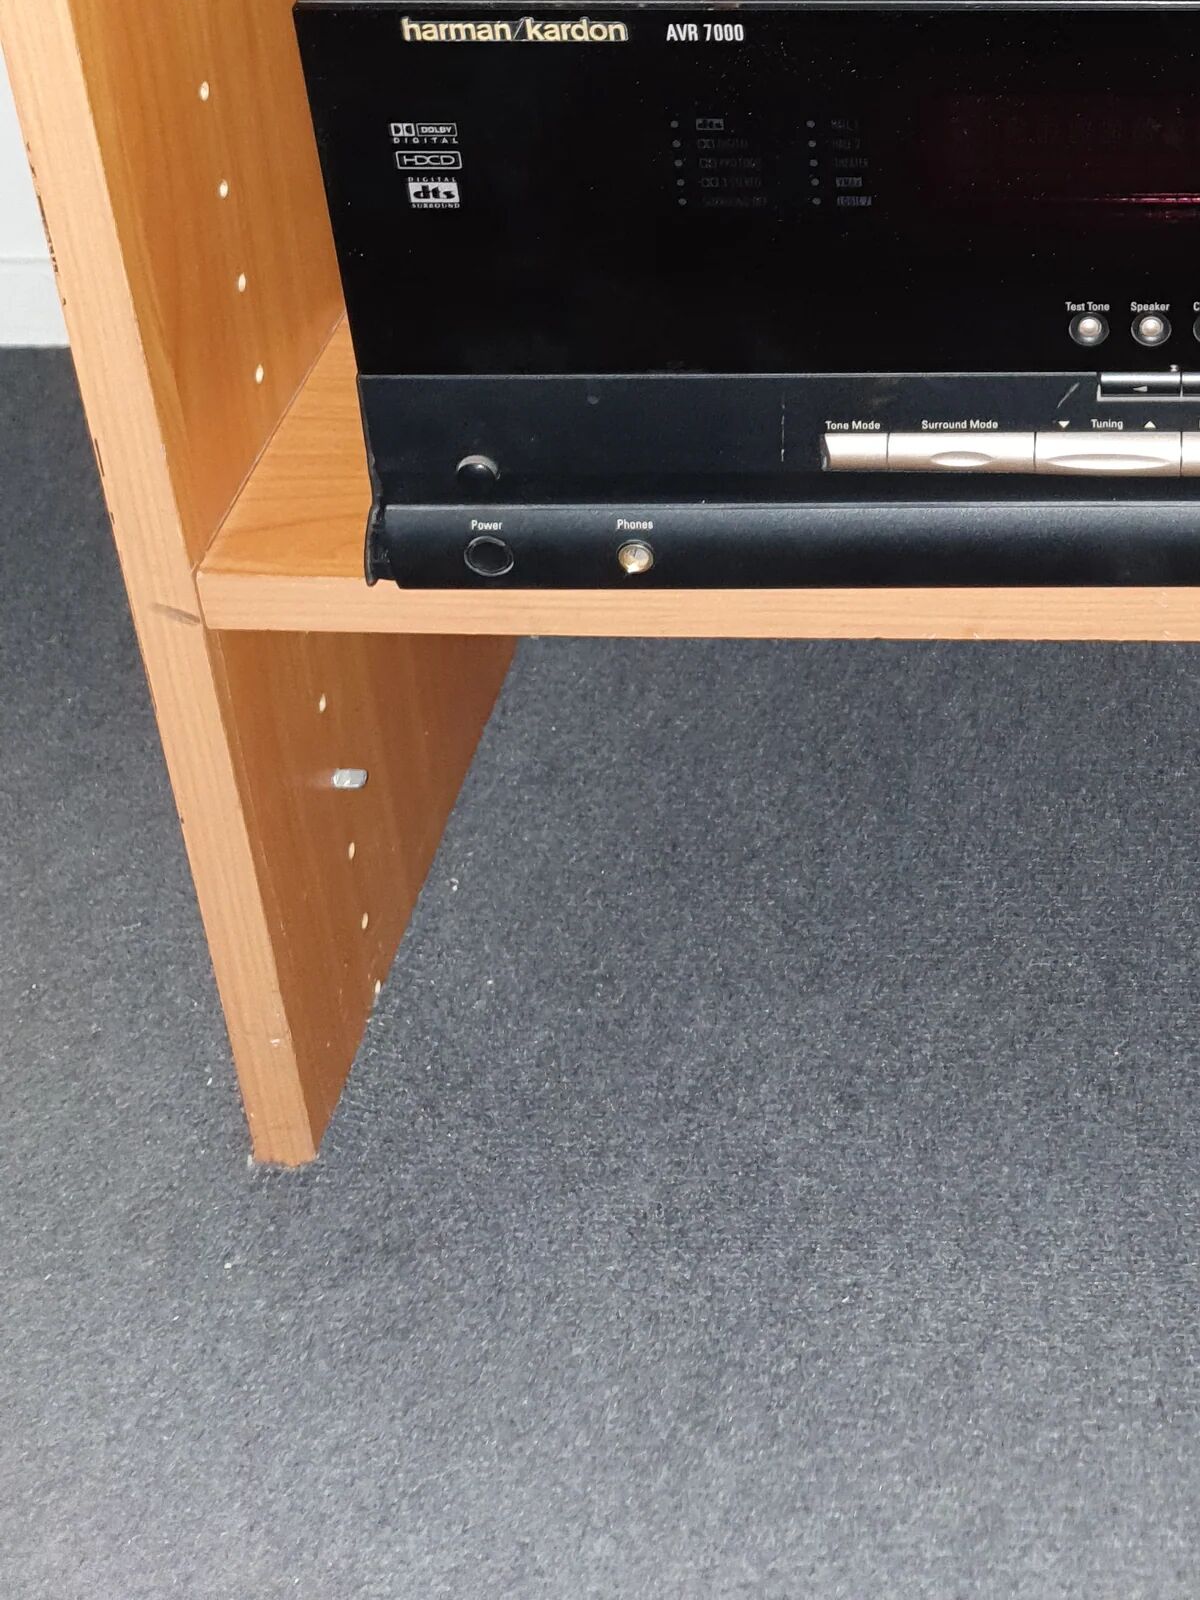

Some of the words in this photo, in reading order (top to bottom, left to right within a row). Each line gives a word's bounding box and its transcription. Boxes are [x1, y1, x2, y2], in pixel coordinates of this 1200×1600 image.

[402, 17, 628, 41] harman/kardon
[666, 24, 699, 41] AVR
[703, 24, 744, 42] 7000
[420, 126, 452, 134] DOLBY
[403, 155, 456, 166] HDCD
[413, 184, 456, 199] dts
[1065, 302, 1086, 312] Test
[1087, 302, 1110, 312] Tone
[1130, 302, 1170, 313] Speaker
[825, 420, 850, 430] Tone
[852, 420, 881, 430] Mode
[921, 419, 967, 430] Surround
[969, 419, 999, 430] Mode
[1090, 419, 1124, 431] Tuning
[471, 520, 503, 531] Power
[617, 519, 653, 530] Phones
